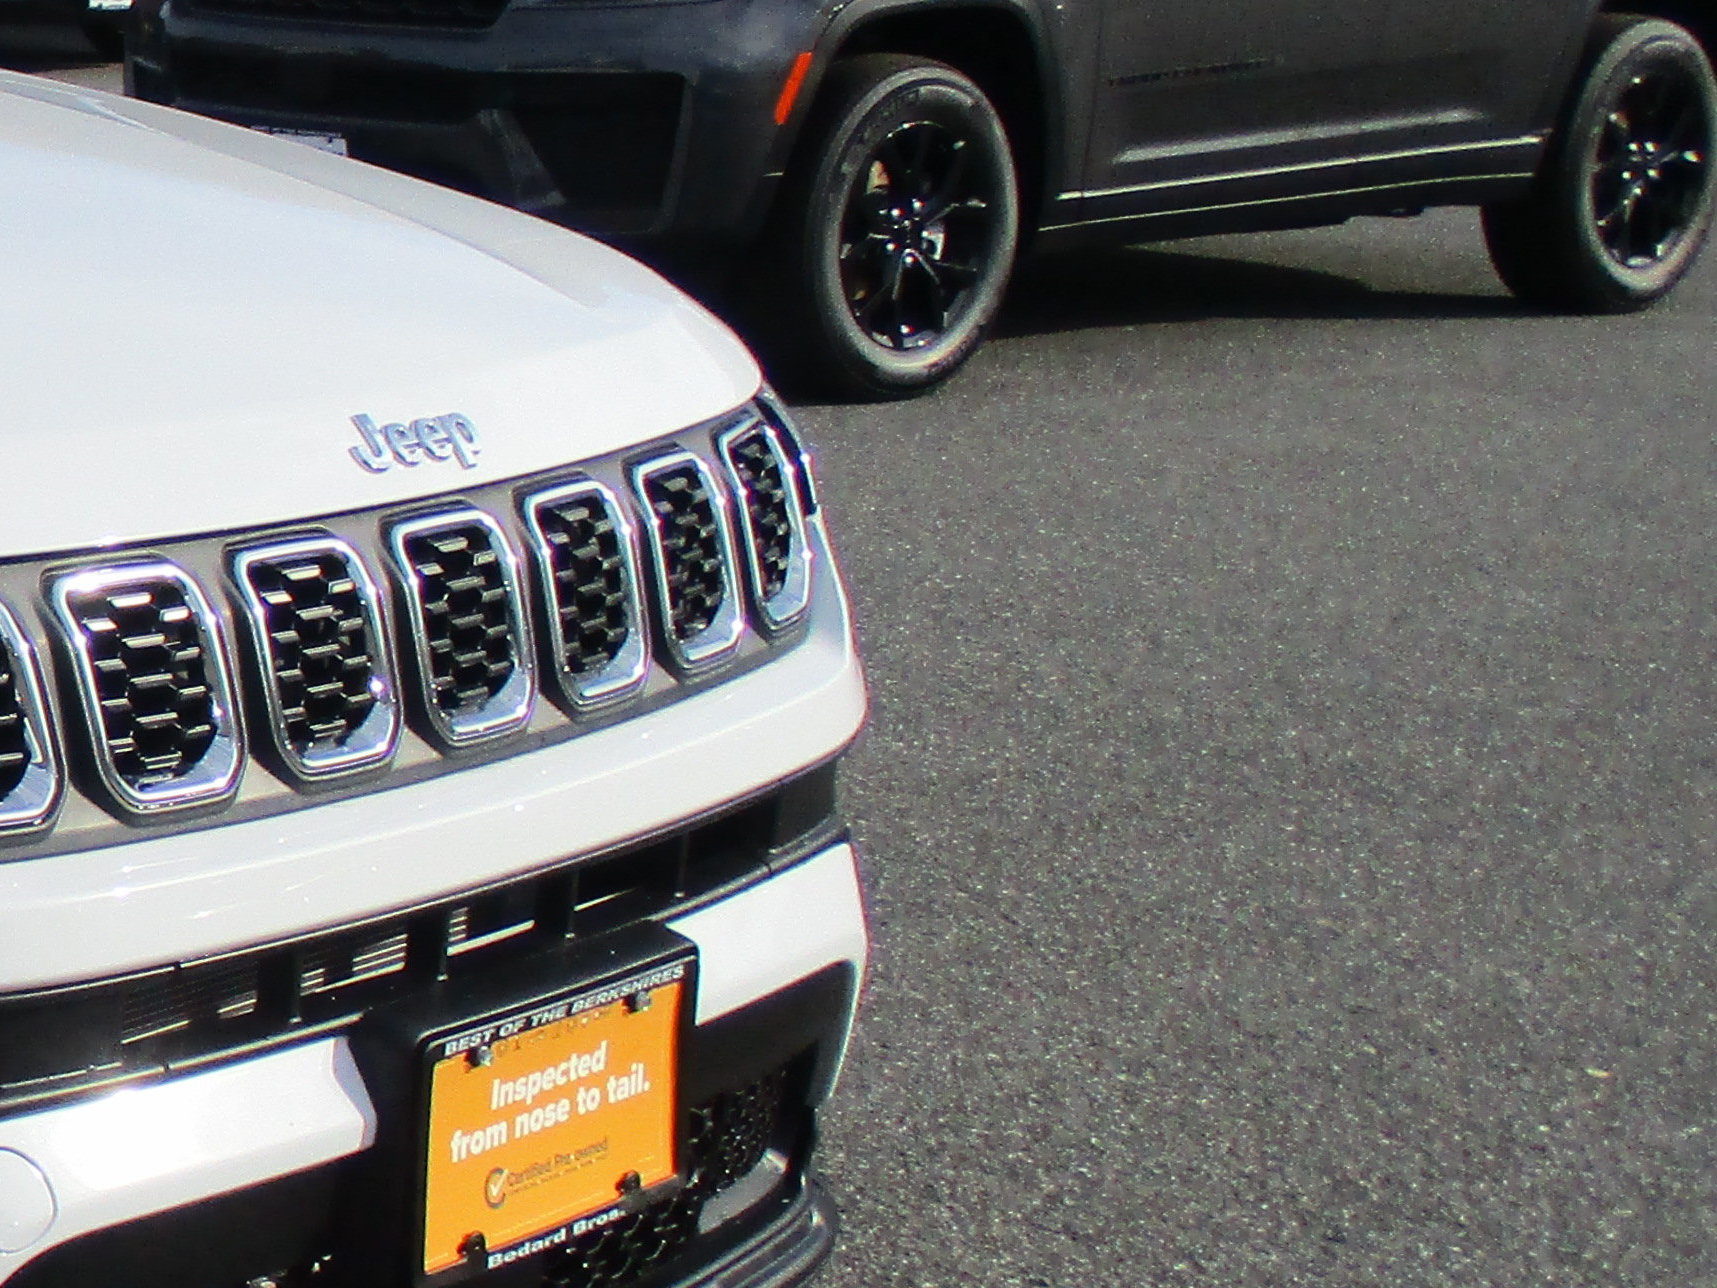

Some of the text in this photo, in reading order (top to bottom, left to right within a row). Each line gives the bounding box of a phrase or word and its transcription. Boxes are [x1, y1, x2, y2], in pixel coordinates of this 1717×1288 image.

[348, 412, 481, 475] Jeep
[444, 1029, 495, 1057] BEST
[499, 1018, 526, 1038] OF
[530, 1004, 569, 1027] THE
[571, 965, 684, 1013] BERKSHIRES
[491, 1040, 607, 1110] Inspected
[450, 1063, 651, 1163] from nose to tail.
[487, 1228, 566, 1269] Bedard
